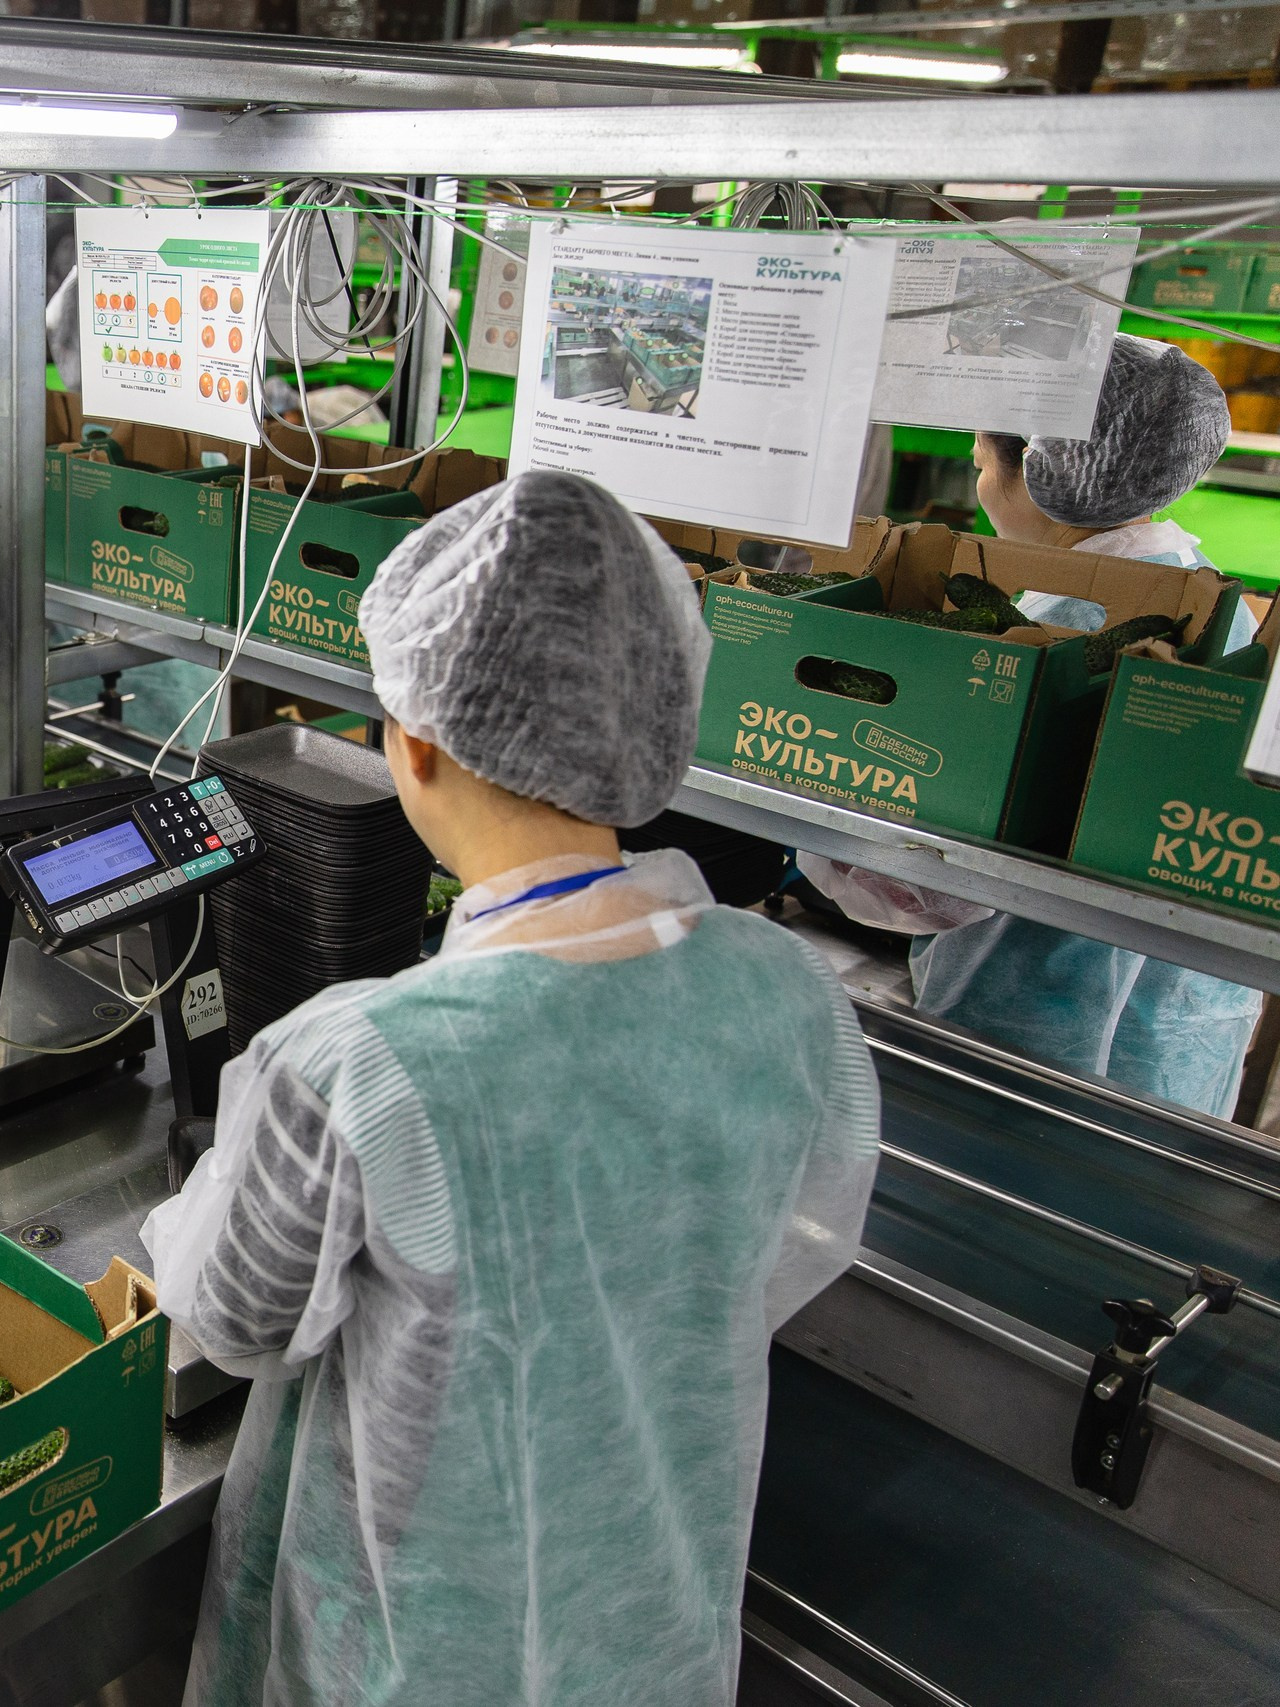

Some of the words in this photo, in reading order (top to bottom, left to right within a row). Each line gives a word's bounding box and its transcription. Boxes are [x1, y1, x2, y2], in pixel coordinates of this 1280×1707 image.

[755, 267, 842, 282] КУЛЬТУРА
[536, 410, 558, 421] Рабочее
[563, 416, 581, 425] место
[586, 421, 610, 430] должно
[616, 425, 659, 437] содержаться
[582, 429, 629, 443] документация
[92, 562, 187, 603] КУЛЬТУРА
[715, 595, 794, 619] aph-ecoculture.ru
[268, 626, 300, 642] овощи,
[301, 635, 307, 643] в
[308, 637, 347, 655] которых
[1131, 674, 1246, 705] aph-ecoculture.ru
[881, 735, 929, 760] СДЕЛАНО
[734, 729, 919, 805] КУЛЬТУРА
[149, 803, 158, 813] 1
[164, 797, 175, 808] 2
[179, 791, 189, 802] 3
[194, 785, 203, 796] T
[731, 757, 781, 782] овощи,
[783, 772, 793, 784] в
[794, 775, 858, 803] которых
[859, 793, 917, 818] уверен
[159, 818, 169, 828] 4
[173, 812, 184, 823] 5
[189, 806, 199, 817] 6
[167, 833, 176, 844] 7
[183, 827, 194, 838] 8
[199, 821, 208, 832] 9
[193, 843, 203, 853] 0
[208, 838, 219, 846] Del
[222, 832, 234, 840] PLU
[199, 858, 216, 870] MENU
[1147, 866, 1217, 895] овощи,
[1222, 886, 1234, 898] в
[188, 982, 218, 1010] 292
[45, 1521, 98, 1565] уверен
